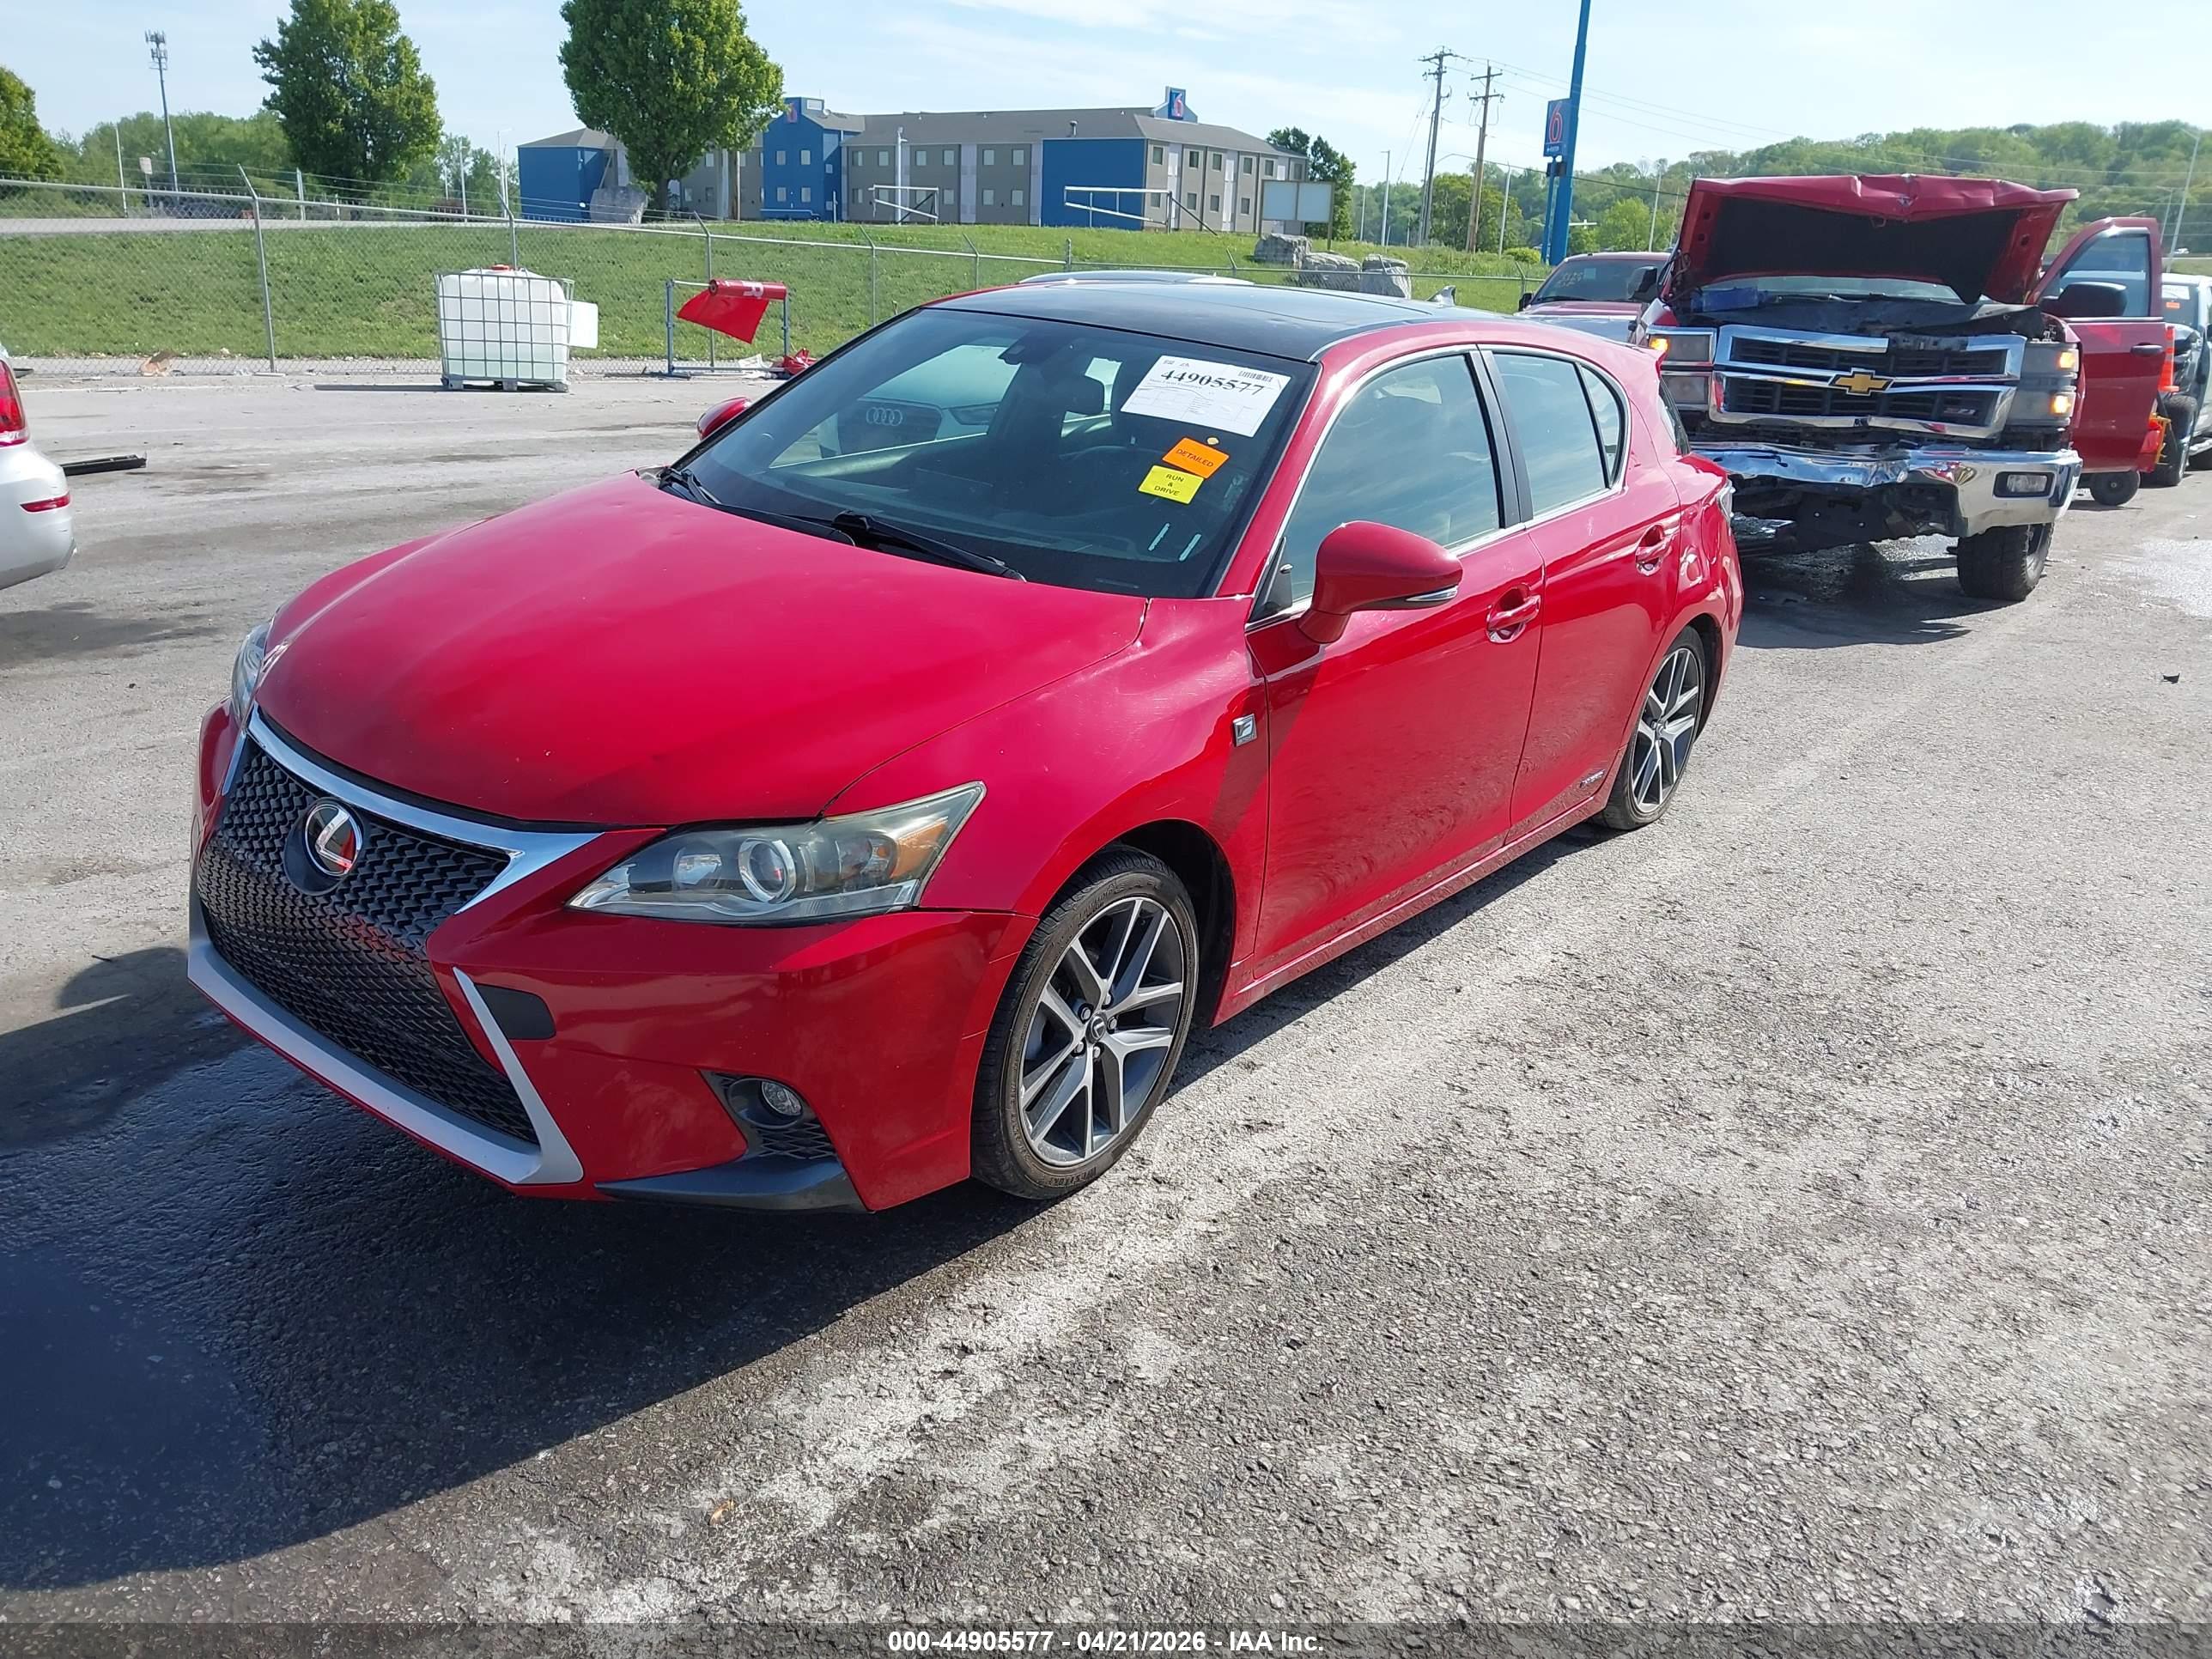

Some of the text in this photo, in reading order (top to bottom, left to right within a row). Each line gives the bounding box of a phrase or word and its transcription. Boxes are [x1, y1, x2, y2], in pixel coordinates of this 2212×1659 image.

[1548, 100, 1563, 143] 6
[1160, 369, 1266, 395] 44905577
[1176, 448, 1214, 467] DETAILED
[1165, 473, 1185, 483] RUN
[1153, 485, 1181, 496] DRIVE
